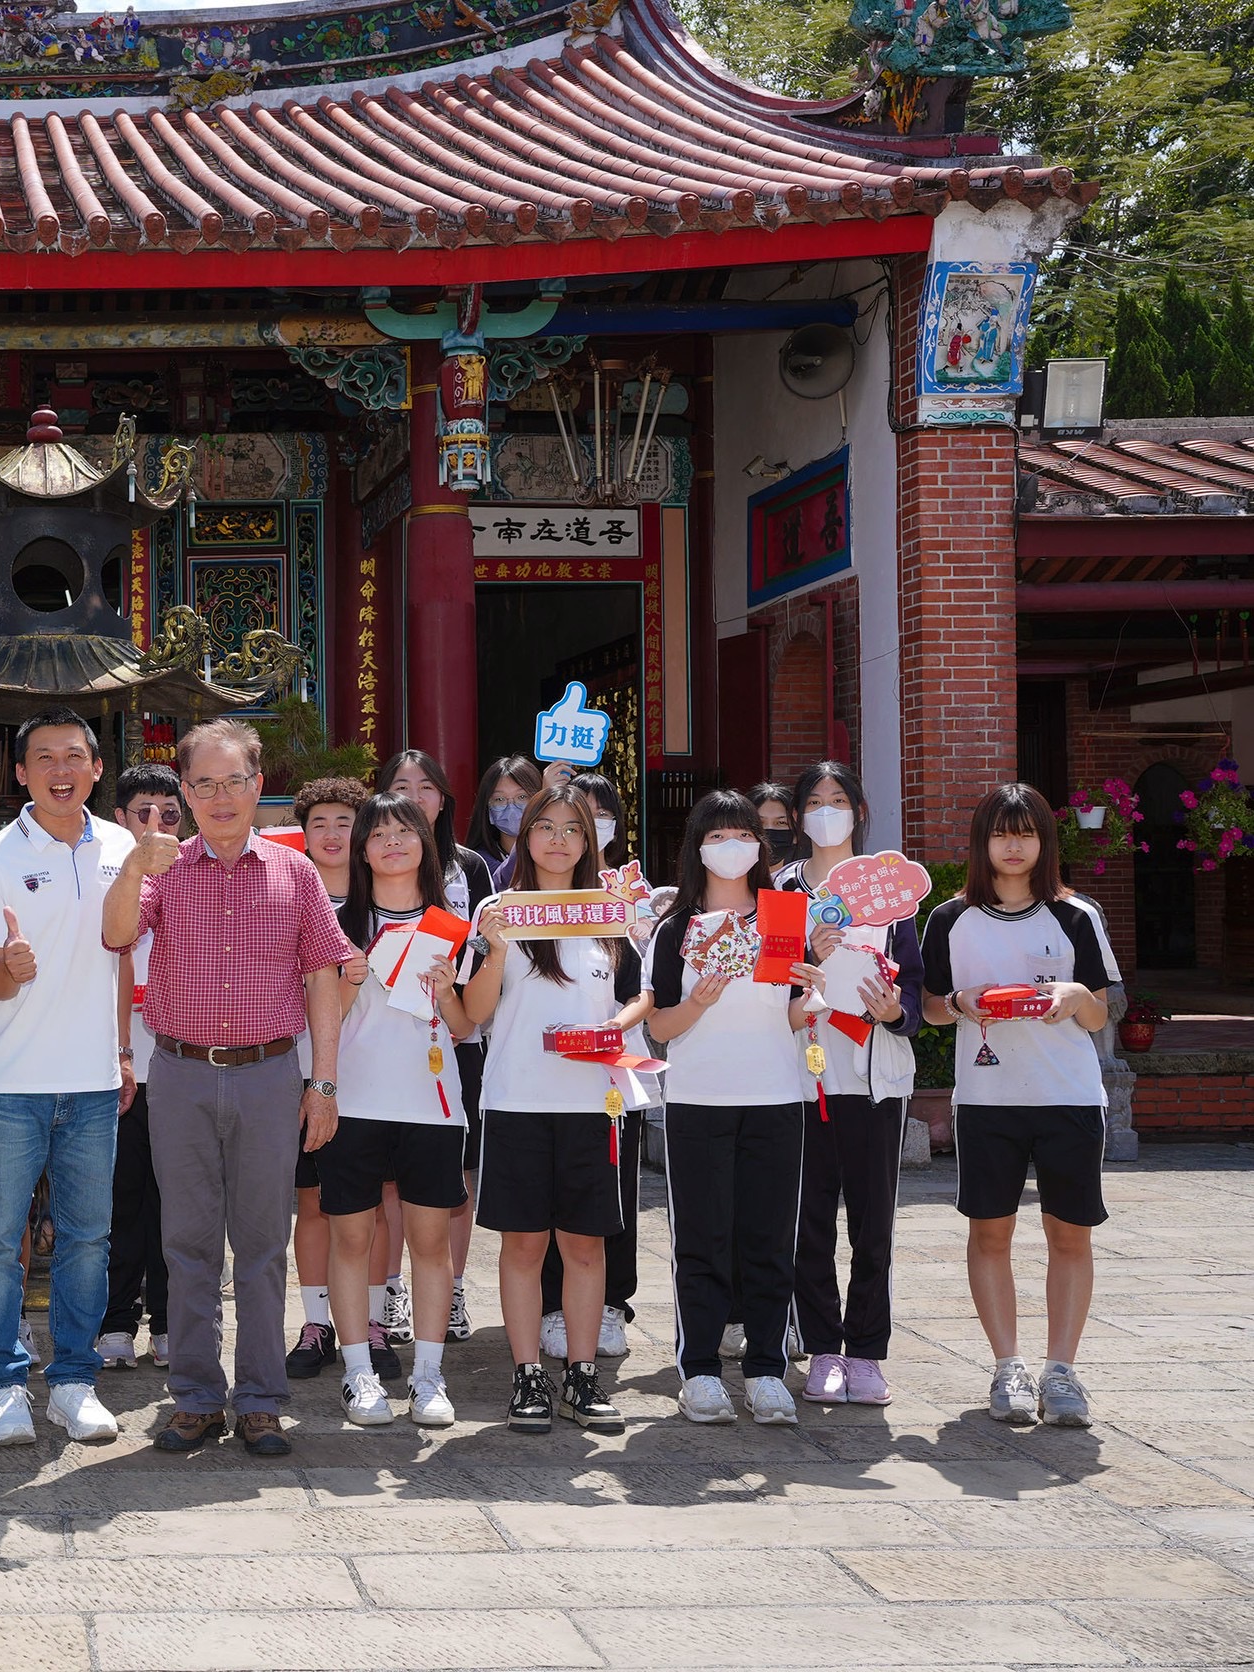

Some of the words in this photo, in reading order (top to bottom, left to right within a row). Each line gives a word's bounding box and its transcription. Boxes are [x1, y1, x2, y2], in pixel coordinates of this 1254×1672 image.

[543, 721, 595, 750] 力挺
[840, 866, 900, 894] 拍的不是照片
[847, 882, 896, 906] 是一段段
[504, 902, 626, 926] 我比風景還美
[861, 889, 914, 918] 青春年華
